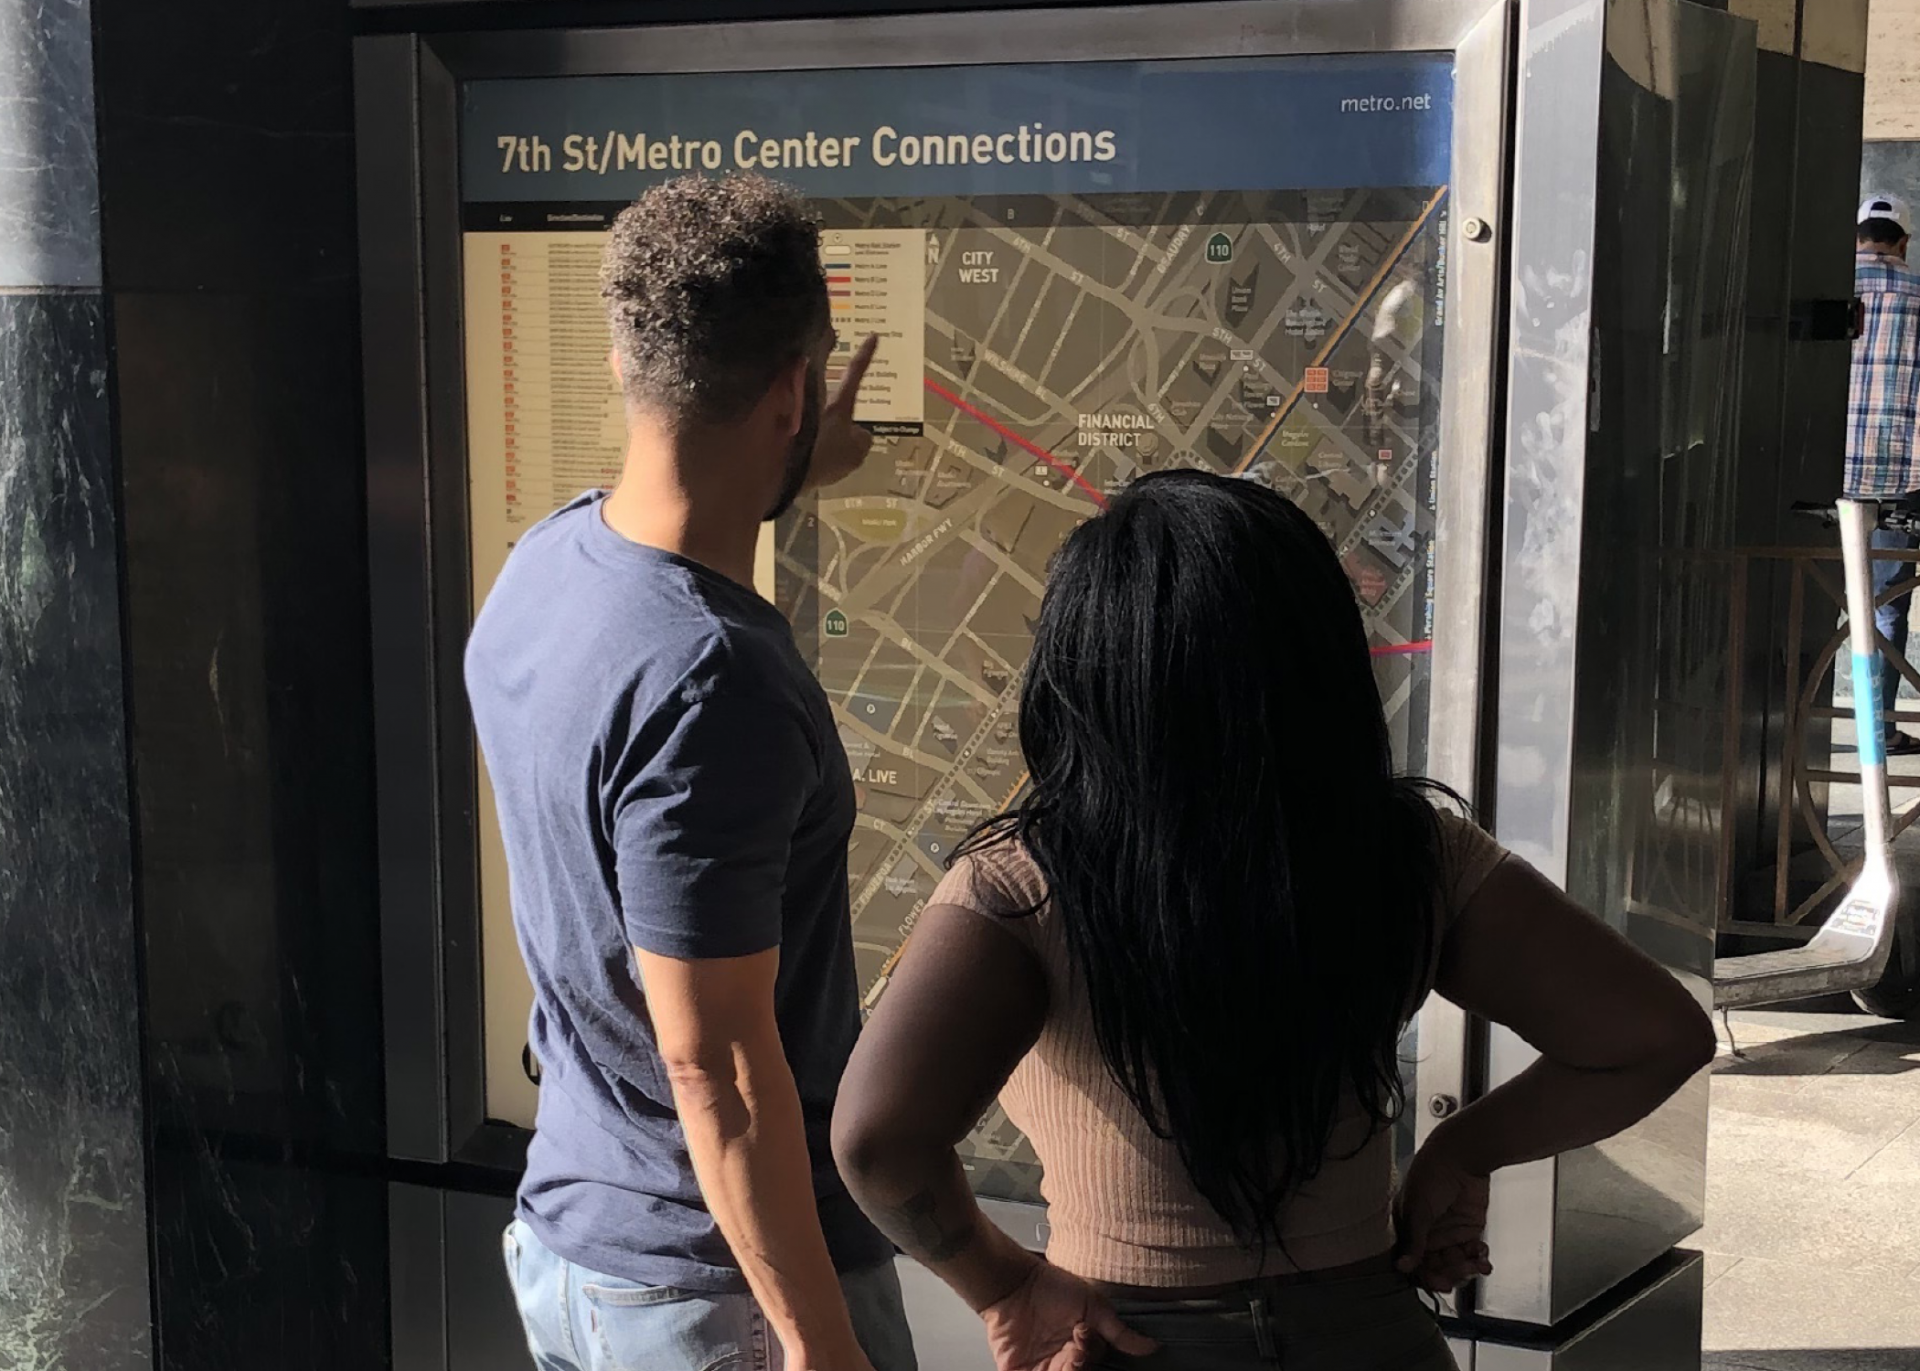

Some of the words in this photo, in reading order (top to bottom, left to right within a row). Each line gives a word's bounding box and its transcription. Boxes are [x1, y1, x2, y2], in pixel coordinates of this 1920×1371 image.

[1341, 93, 1431, 112] metro.net
[497, 135, 551, 173] 7th
[562, 131, 722, 174] St/Metro
[733, 130, 860, 170] Center
[872, 122, 1116, 166] Connections
[1209, 243, 1230, 258] 110
[962, 252, 994, 267] CITY
[958, 268, 999, 284] WEST
[1078, 413, 1155, 429] FINANCIAL
[1078, 432, 1142, 447] DISTRICT
[827, 620, 845, 632] 110
[869, 769, 897, 785] LIVE
